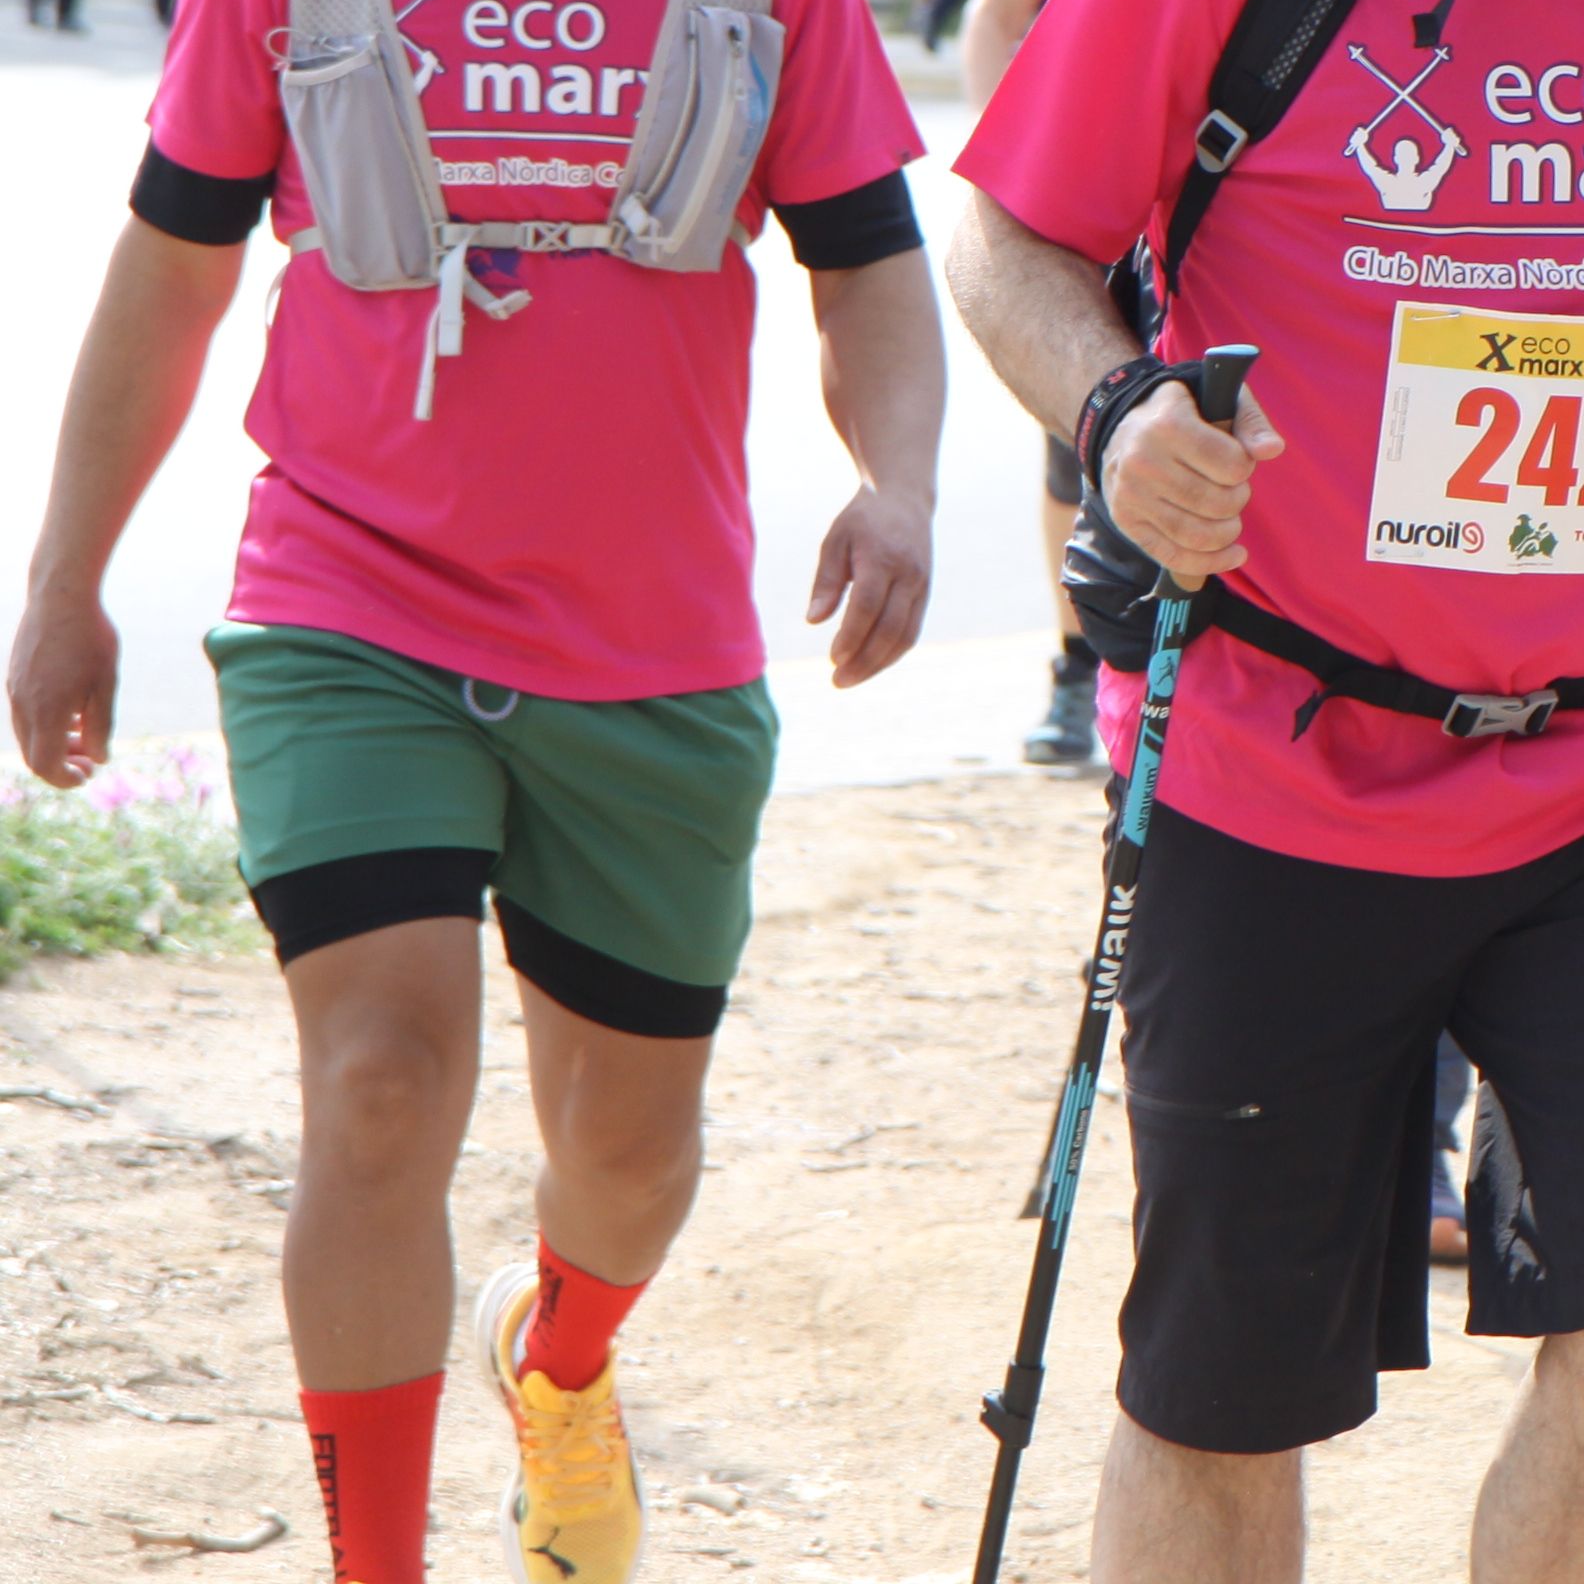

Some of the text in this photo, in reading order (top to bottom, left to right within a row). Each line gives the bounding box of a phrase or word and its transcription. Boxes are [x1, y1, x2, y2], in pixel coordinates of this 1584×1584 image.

[463, 63, 652, 119] mar
[434, 157, 496, 184] arxa
[499, 157, 592, 186] Nòrdica
[1346, 248, 1415, 281] Club
[1423, 255, 1512, 286] Marxa
[1476, 332, 1570, 373] X eco
[1376, 519, 1459, 549] nuroil
